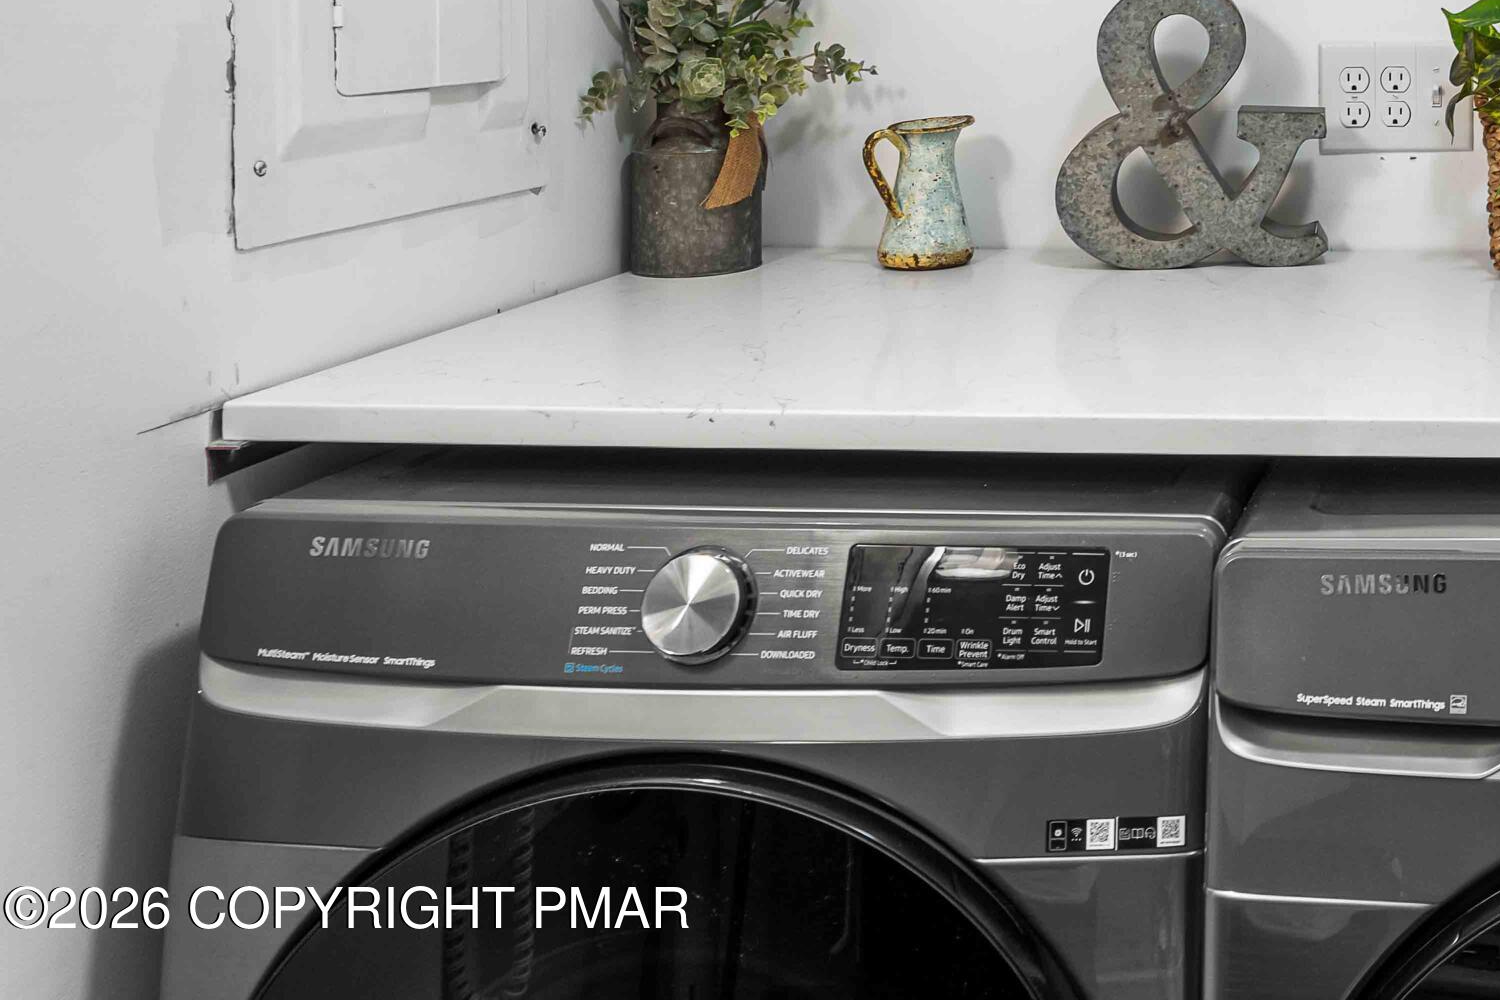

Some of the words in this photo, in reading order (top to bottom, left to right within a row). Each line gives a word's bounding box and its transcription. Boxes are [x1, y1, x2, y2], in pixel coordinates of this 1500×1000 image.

[309, 535, 431, 560] SAMSUNG
[590, 543, 625, 552] NORMAL
[786, 546, 829, 556] DELICATES
[585, 566, 613, 575] HEAVY
[613, 566, 636, 575] DUTY
[1013, 562, 1026, 570] Eco
[1038, 563, 1061, 572] Adjust
[773, 569, 826, 578] ACTIVEWEAR
[1012, 571, 1025, 580] Dry
[1319, 573, 1447, 596] SAMSUNG
[581, 586, 619, 595] BEDDING
[780, 589, 805, 599] QUICK
[805, 589, 823, 599] DRY
[1005, 595, 1026, 604] Damp
[1035, 595, 1058, 605] Adjust
[577, 606, 601, 615] PERM
[601, 606, 629, 615] PRESS
[1005, 604, 1024, 612] Alert
[783, 609, 803, 619] TIME
[803, 609, 821, 619] DRY
[574, 626, 601, 636] STEAM
[777, 630, 793, 640] AIR
[793, 630, 818, 639] FLUFF
[1002, 627, 1023, 636] Drum
[1034, 627, 1056, 636] Smart
[959, 641, 989, 650] Wrinkle
[1002, 636, 1021, 647] Light
[1031, 636, 1057, 646] Control
[570, 646, 608, 656] REFRESH
[844, 642, 876, 655] Dryness
[886, 643, 910, 655] Temp.
[926, 644, 946, 654] Time
[759, 650, 816, 660] DOWNLOADED
[958, 650, 989, 659] Prevent
[348, 654, 380, 665] Sensor
[383, 656, 436, 669] SmartThings
[1296, 692, 1353, 707] SuperSpeed
[1355, 696, 1387, 707] Steam
[1389, 698, 1446, 712] SmartThings
